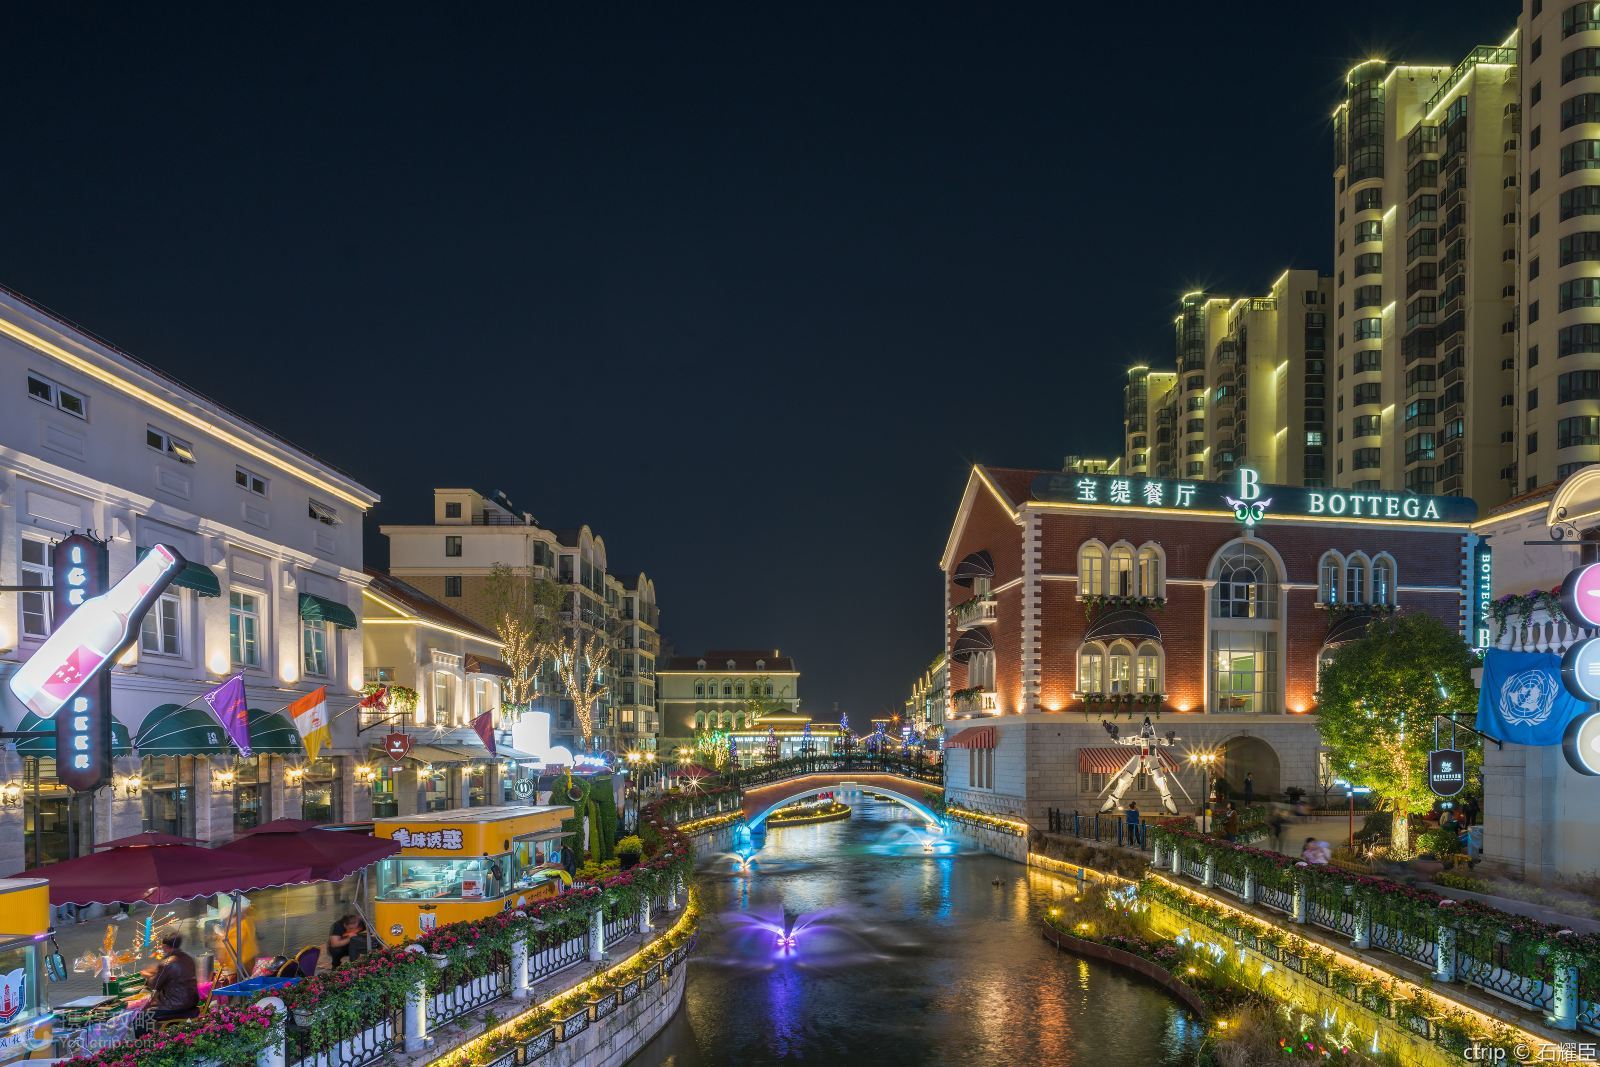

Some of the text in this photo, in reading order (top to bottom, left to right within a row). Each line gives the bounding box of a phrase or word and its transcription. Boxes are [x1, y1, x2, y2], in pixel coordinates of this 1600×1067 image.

[1076, 478, 1196, 507] 宝缇餐厅
[1239, 468, 1260, 500] B
[1308, 493, 1440, 519] BOTTEGA
[1481, 554, 1491, 621] BOTTEGA
[74, 697, 89, 769] BEER
[391, 828, 463, 850] 美味诱惑
